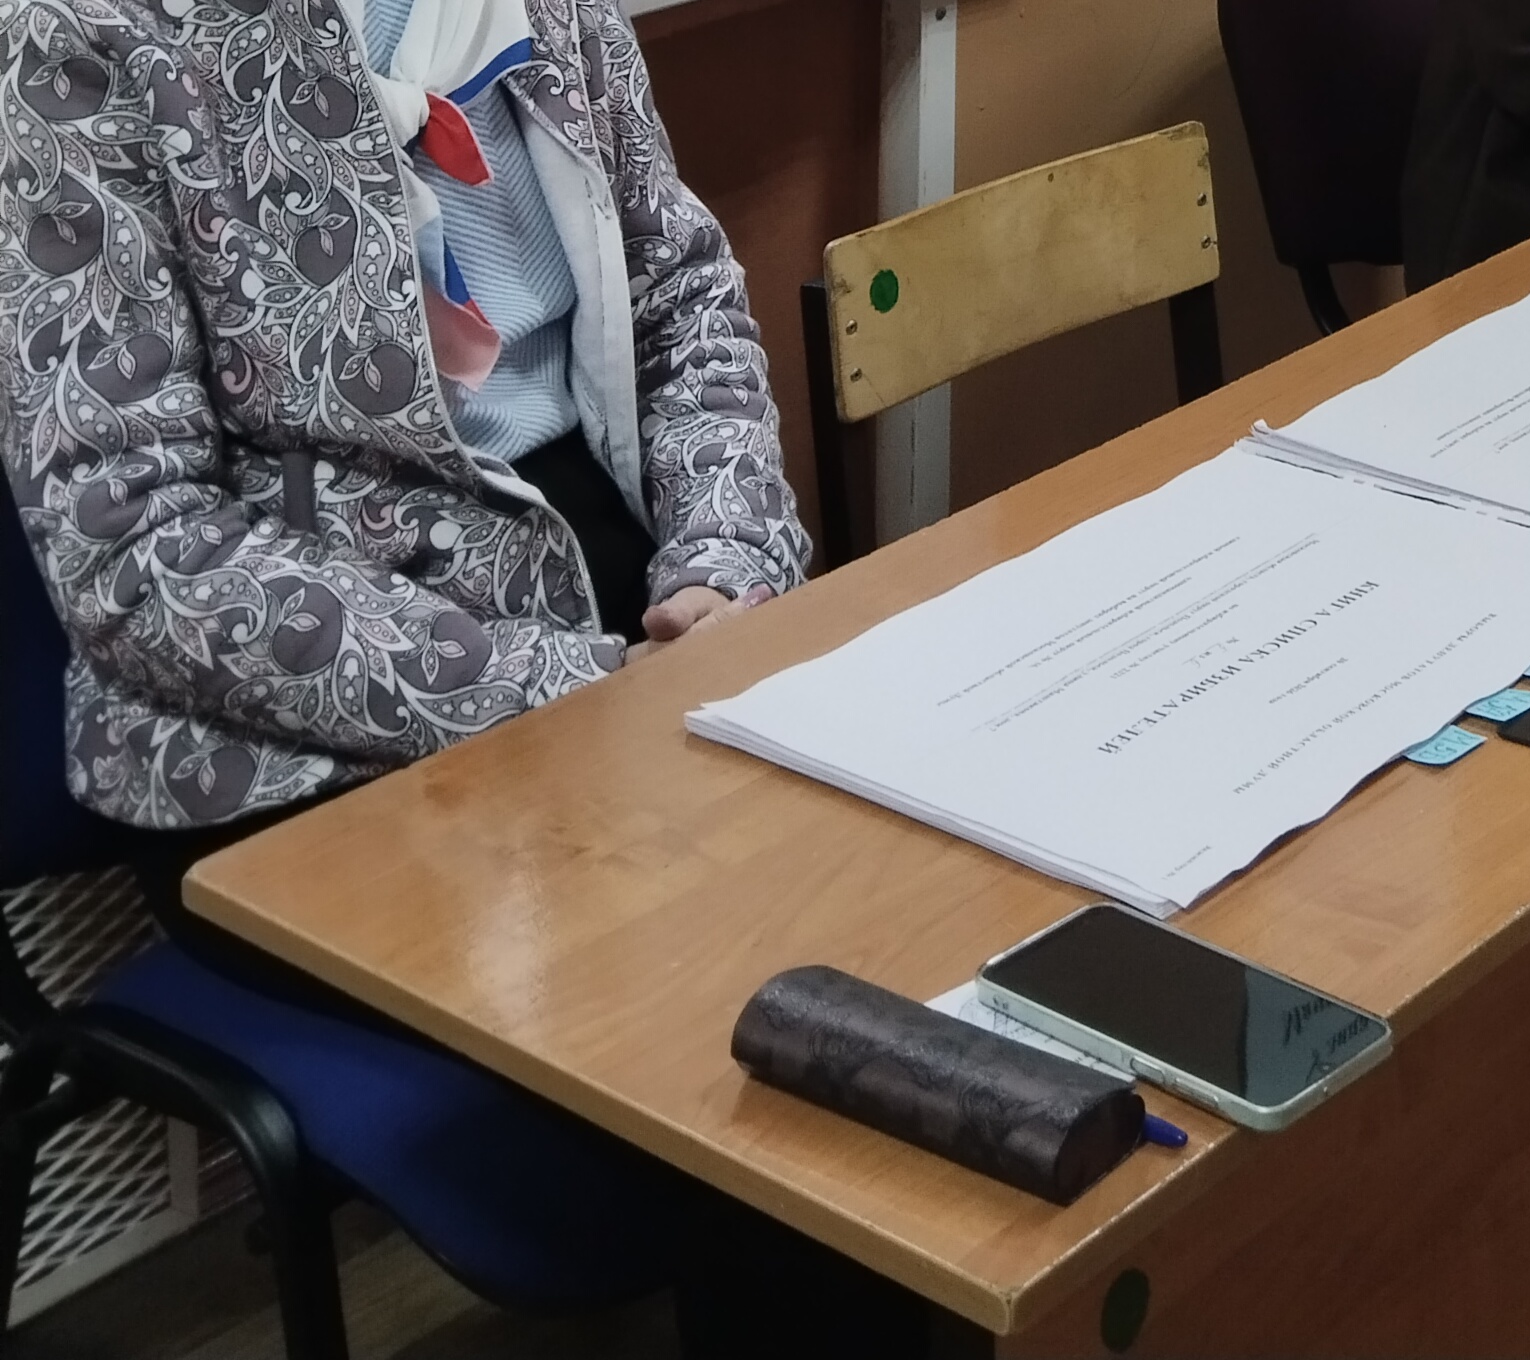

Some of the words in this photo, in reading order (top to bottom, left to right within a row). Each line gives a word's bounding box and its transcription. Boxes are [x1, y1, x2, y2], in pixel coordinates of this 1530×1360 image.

[1314, 580, 1380, 616] КНИГА
[1237, 619, 1318, 663] СПИСКА
[1097, 665, 1242, 754] ИЗБИРАТЕЛЕЙ
